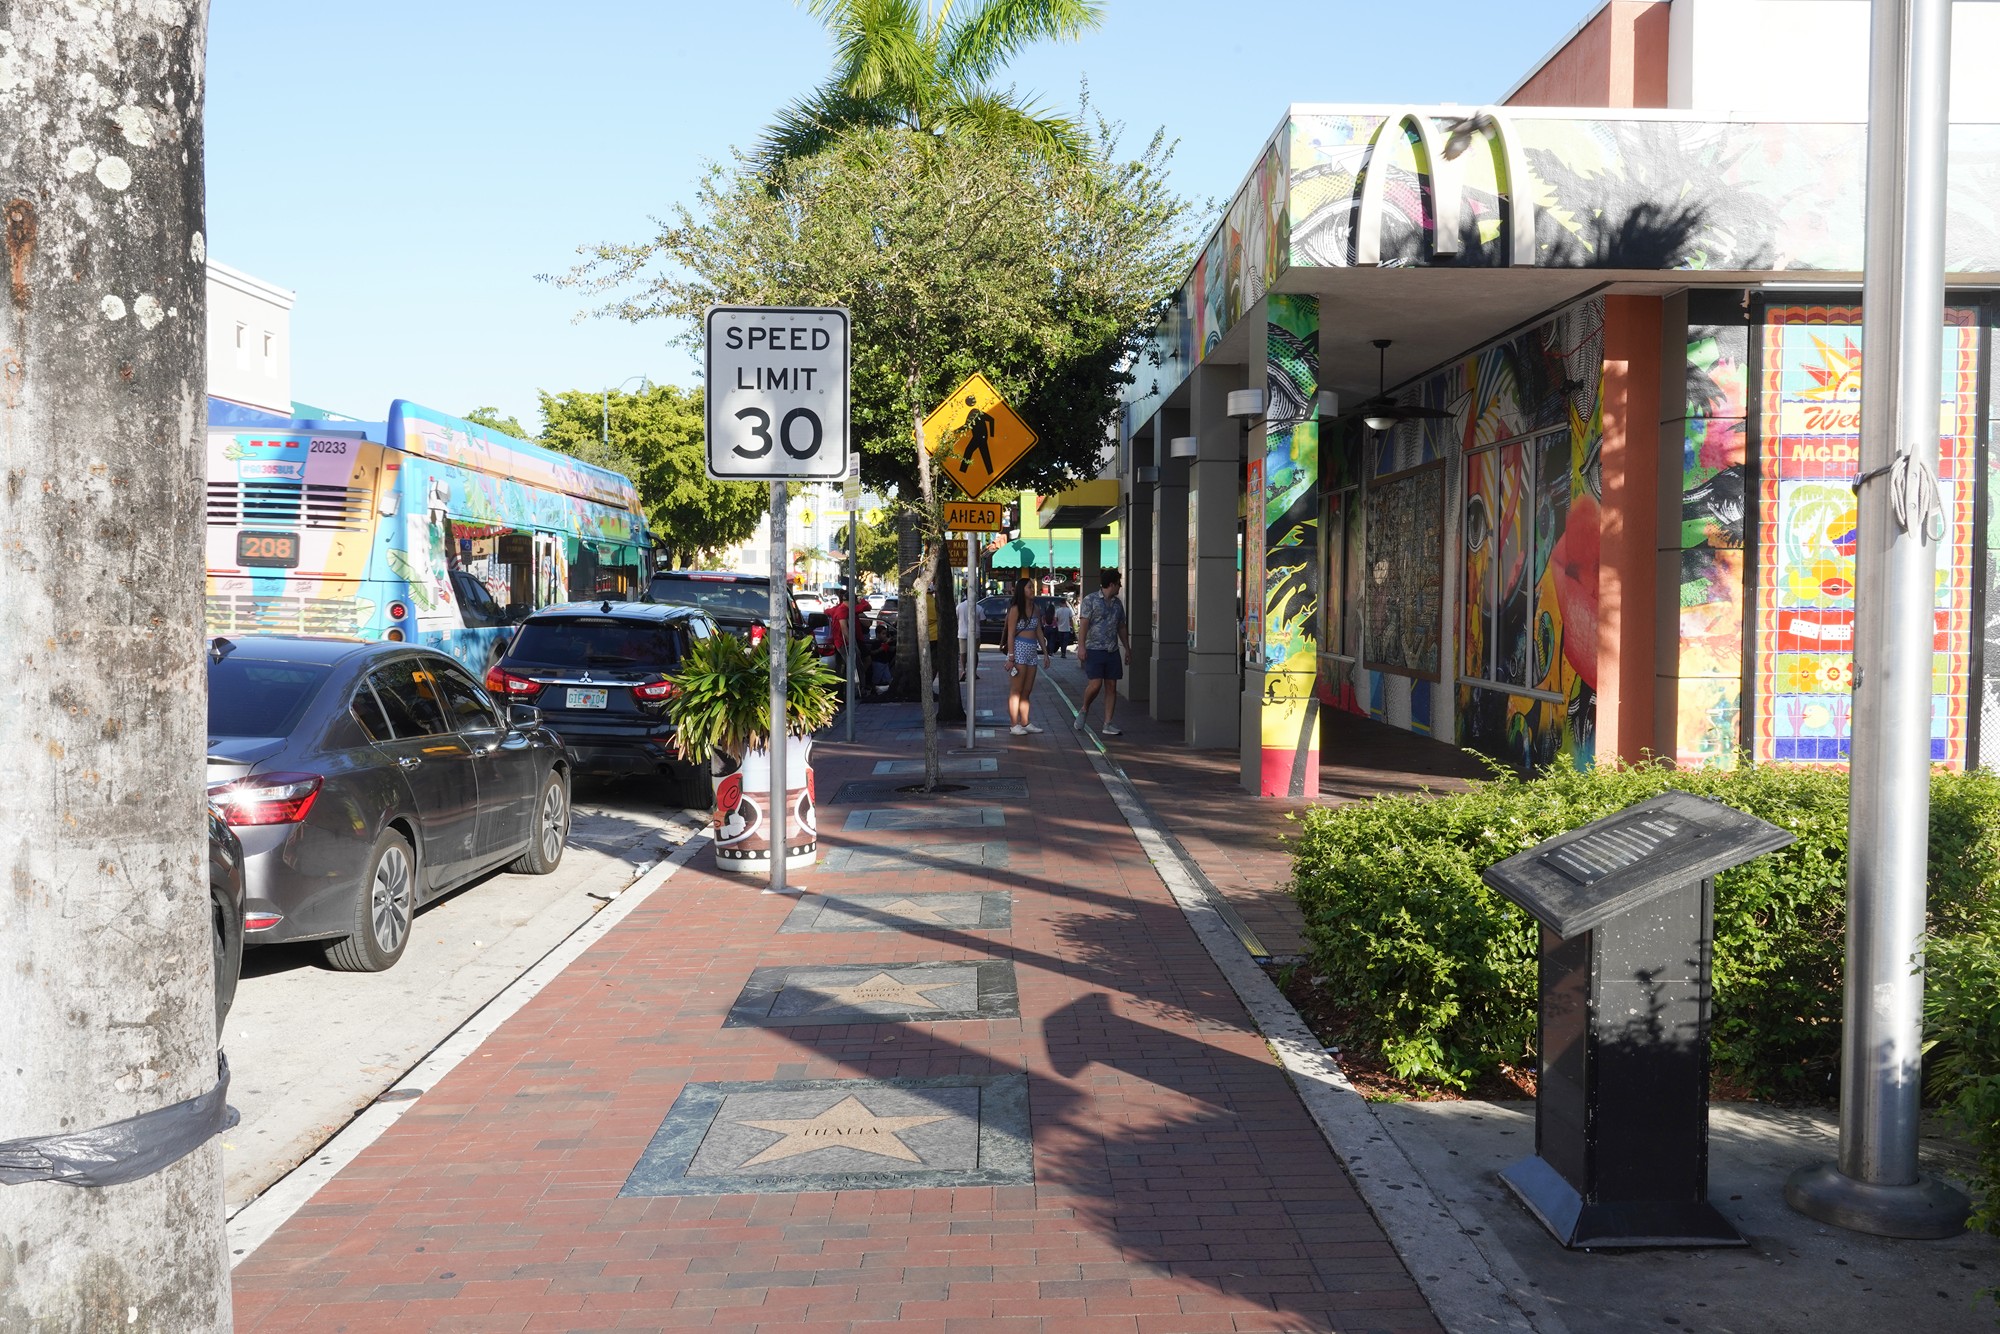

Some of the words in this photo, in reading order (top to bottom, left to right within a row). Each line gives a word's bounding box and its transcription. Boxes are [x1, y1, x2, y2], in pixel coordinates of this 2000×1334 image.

[725, 326, 830, 351] SPEED
[737, 367, 818, 391] LIMIT
[732, 406, 823, 461] 30
[310, 440, 347, 454] 20233
[950, 509, 995, 524] AHEAD
[245, 537, 291, 558] 208
